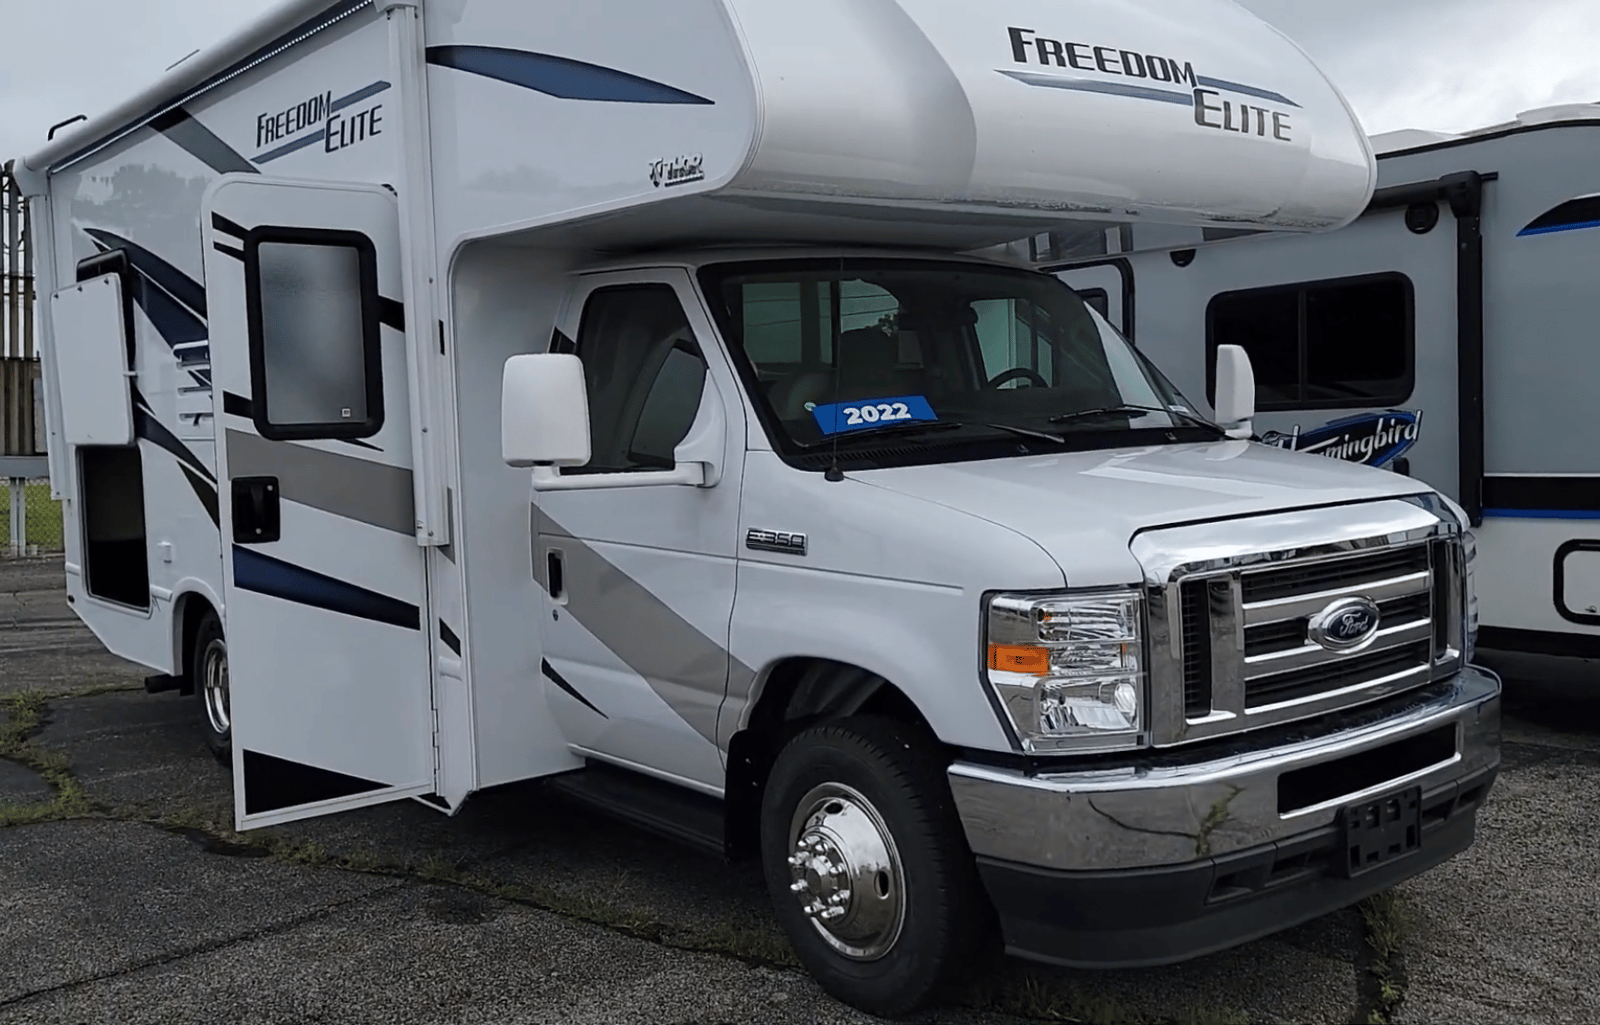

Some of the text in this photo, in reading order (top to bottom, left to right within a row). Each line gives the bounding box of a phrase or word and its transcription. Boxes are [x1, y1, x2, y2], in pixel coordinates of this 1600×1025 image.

[1007, 26, 1198, 88] FREEDOM
[256, 90, 332, 148] FREEDOM
[324, 103, 383, 153] ELITE
[1193, 87, 1292, 142] ELITE
[842, 402, 912, 425] 2022
[1340, 612, 1369, 636] Ford
